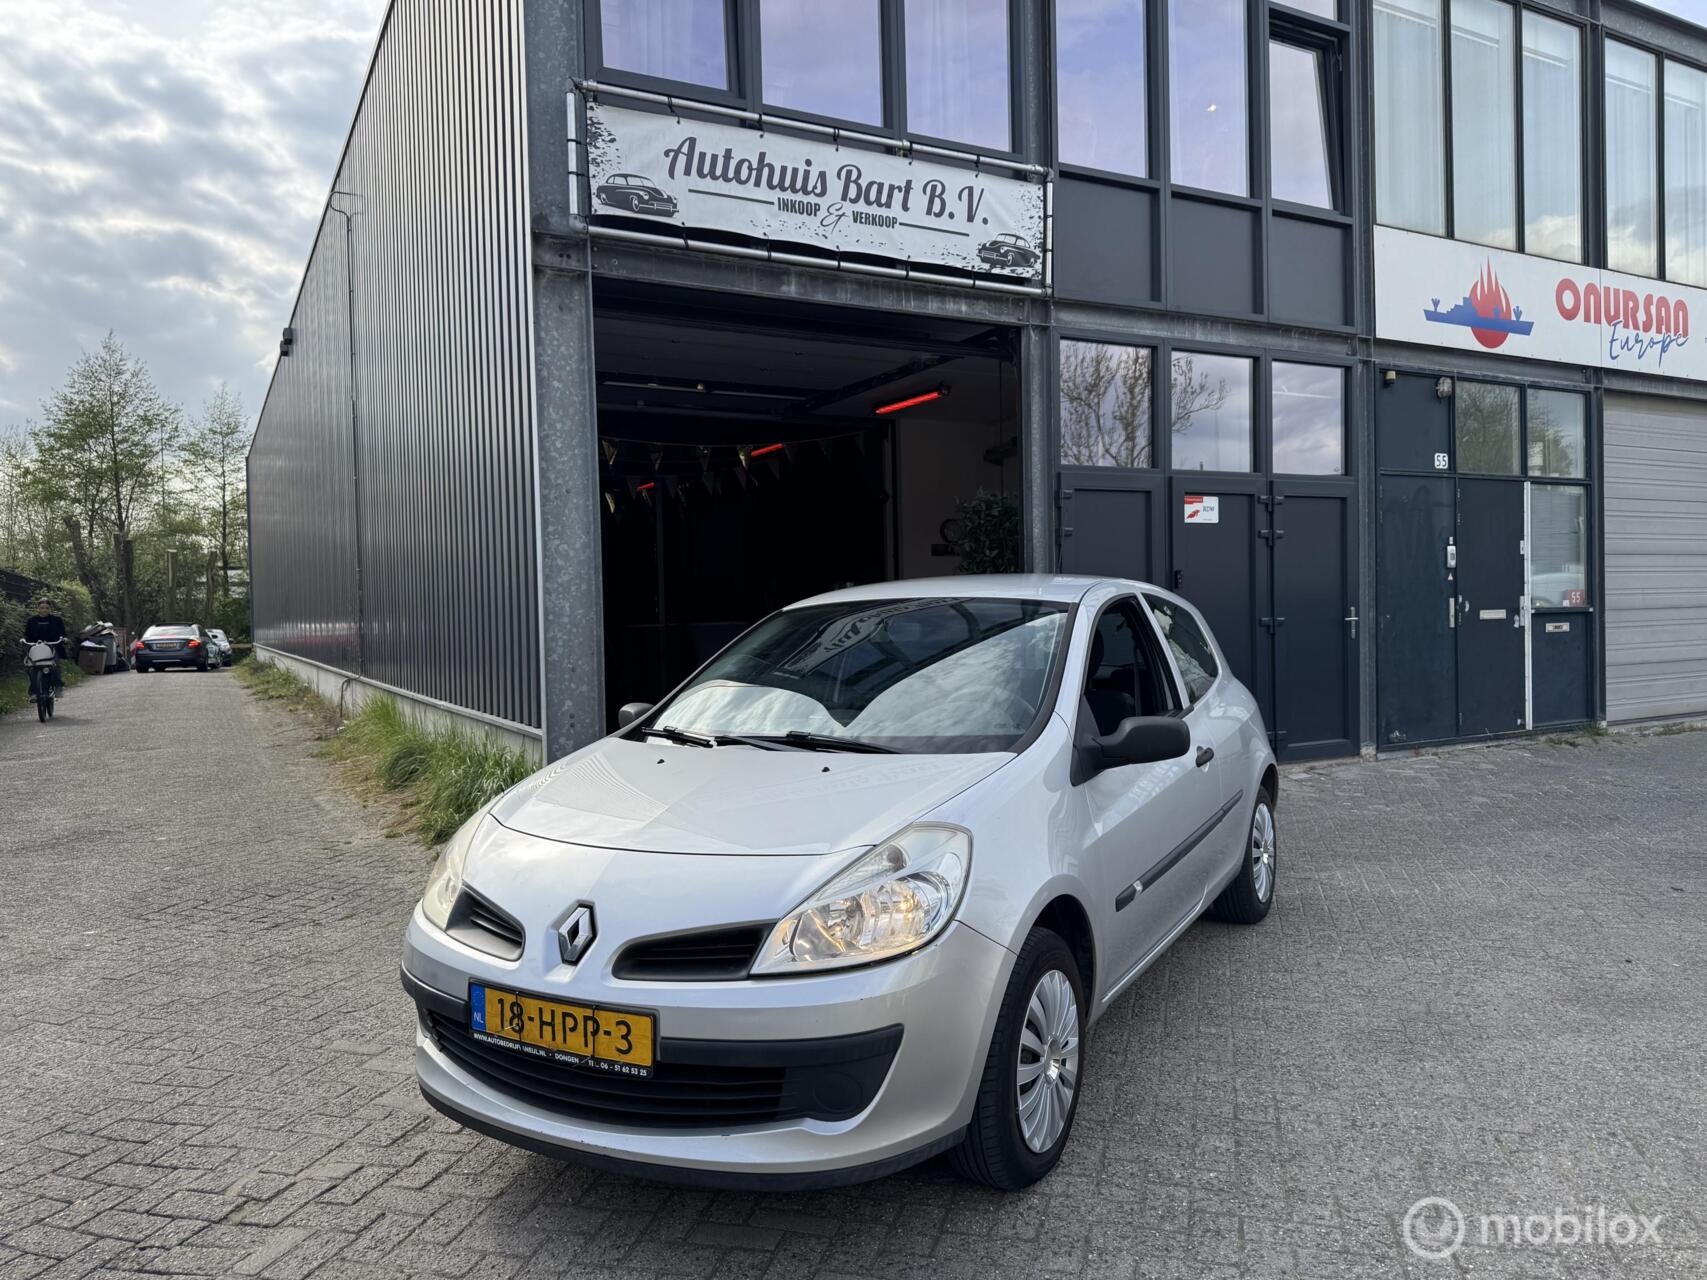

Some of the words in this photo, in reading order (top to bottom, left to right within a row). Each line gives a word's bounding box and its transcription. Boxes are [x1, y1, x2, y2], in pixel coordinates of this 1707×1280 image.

[663, 136, 829, 198] Autohuis
[836, 164, 915, 213] Bart
[922, 178, 990, 226] B.V.
[777, 197, 821, 218] INKOOP
[851, 210, 899, 229] VERKOOP
[1555, 278, 1690, 339] ONURSAN
[1608, 320, 1690, 368] Europe
[1436, 455, 1447, 467] 55
[1571, 591, 1581, 604] 55
[473, 1011, 484, 1024] NL
[498, 998, 633, 1055] 18-HPP-3
[554, 1052, 580, 1064] DONGEN
